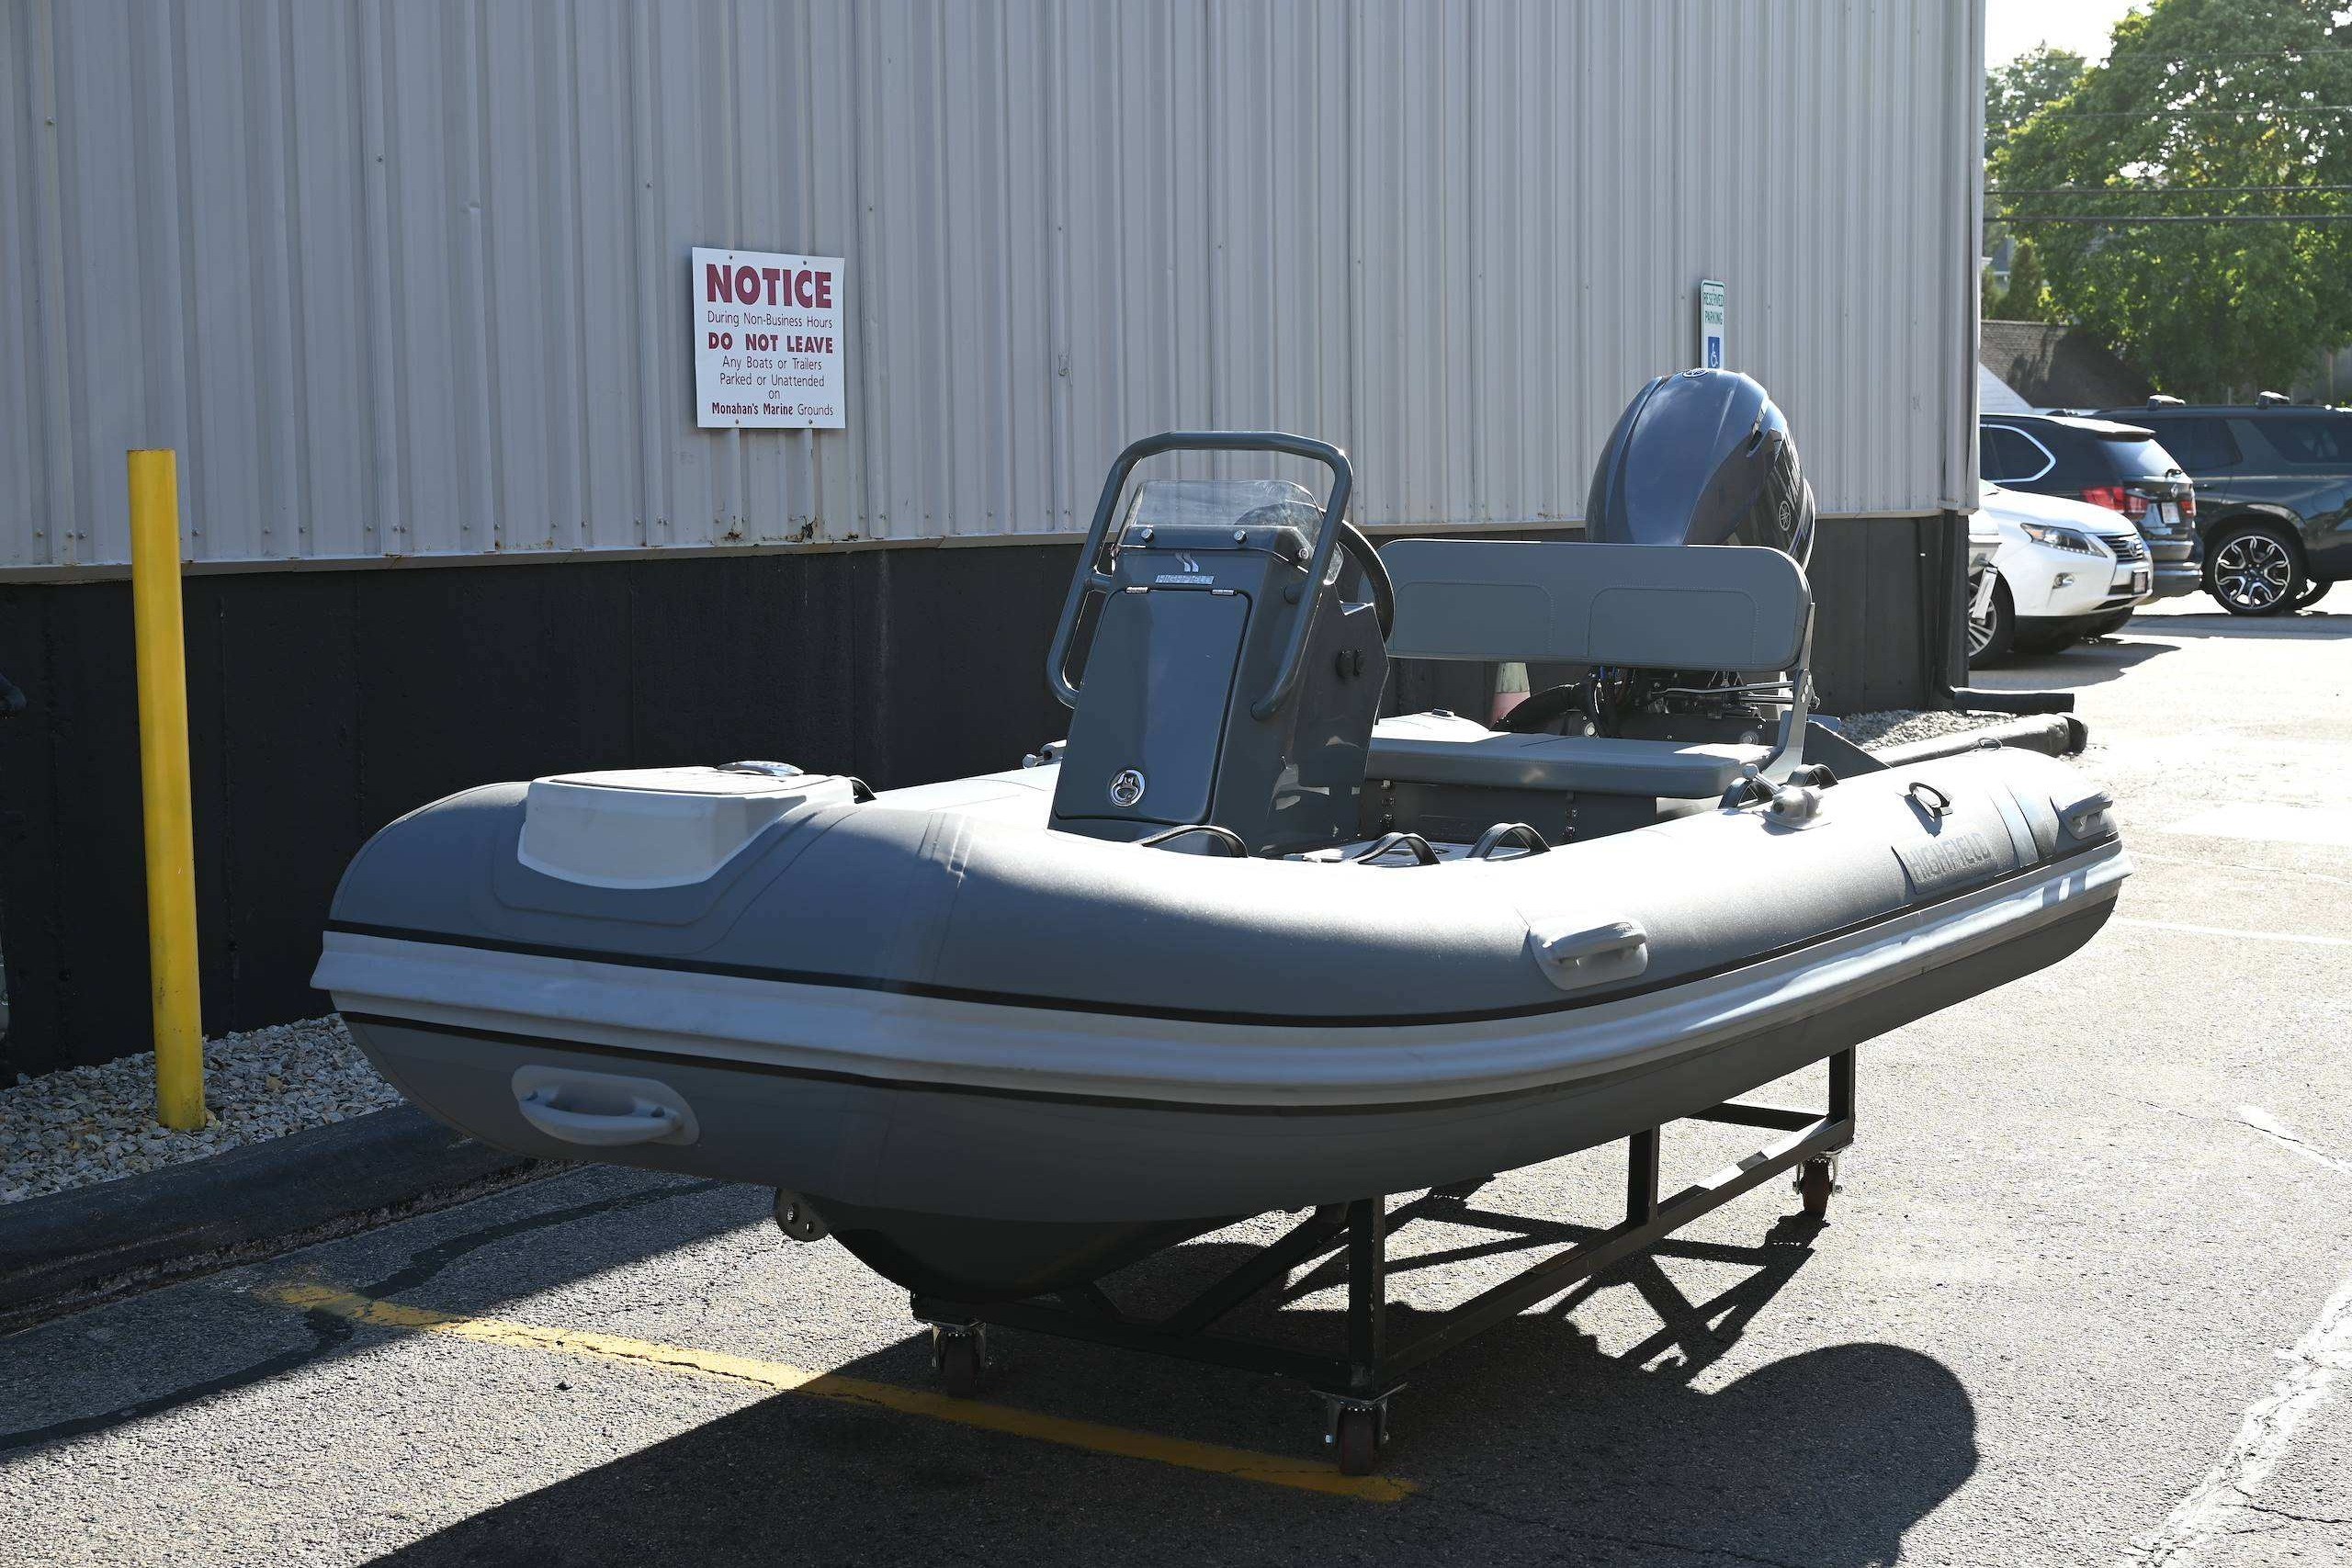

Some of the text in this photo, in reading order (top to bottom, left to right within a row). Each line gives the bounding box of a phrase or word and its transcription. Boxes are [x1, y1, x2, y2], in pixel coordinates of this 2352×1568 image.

[706, 264, 831, 309] NOTICE
[707, 310, 833, 329] During Non-Business Hours
[708, 332, 833, 354] DO NOT LEAVE
[722, 355, 822, 371] Any Boats or Trailers
[719, 372, 825, 388] Parked or Unattended
[768, 389, 781, 400] on
[712, 402, 834, 416] Monahan's Marine Grounds
